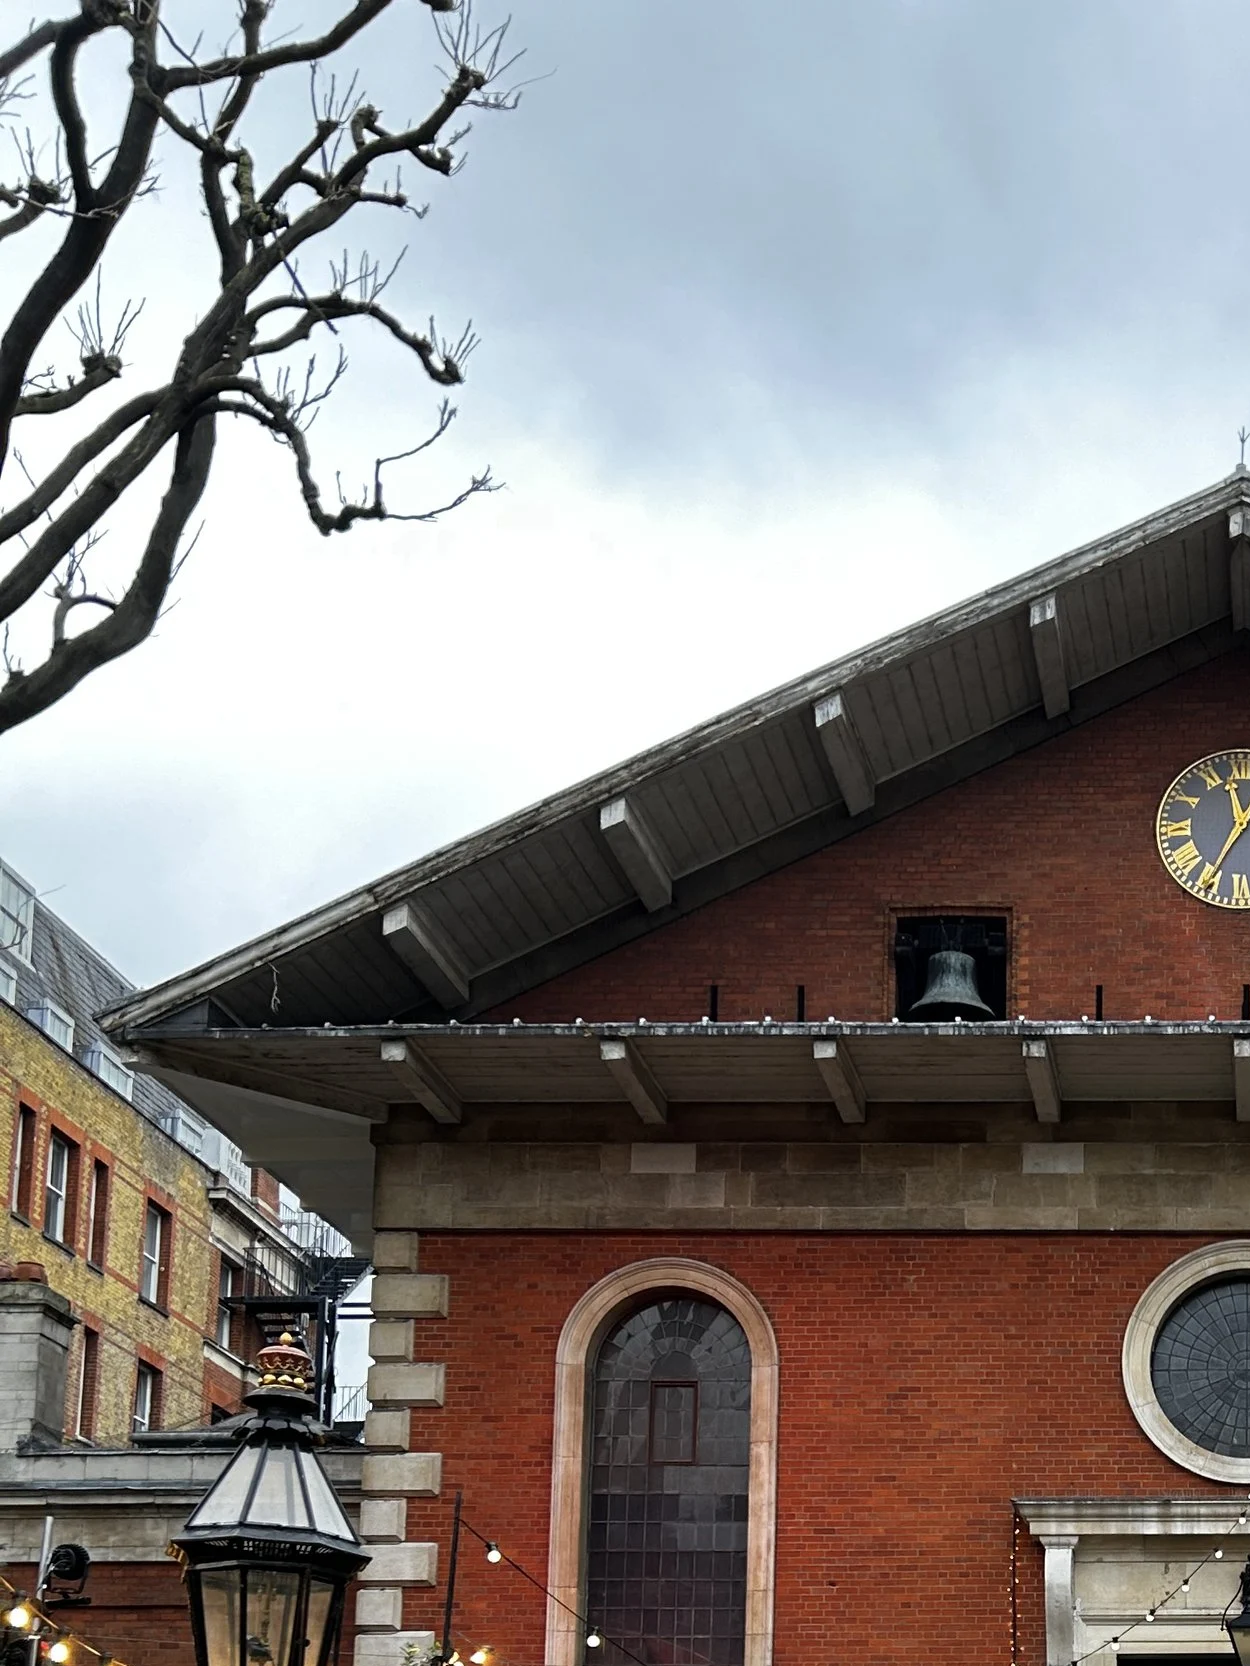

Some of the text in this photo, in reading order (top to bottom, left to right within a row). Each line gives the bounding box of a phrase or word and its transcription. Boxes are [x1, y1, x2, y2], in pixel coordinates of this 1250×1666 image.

[1197, 766, 1223, 791] XI
[1174, 790, 1200, 809] X
[1166, 817, 1191, 838] IX
[1171, 839, 1203, 877] VIII
